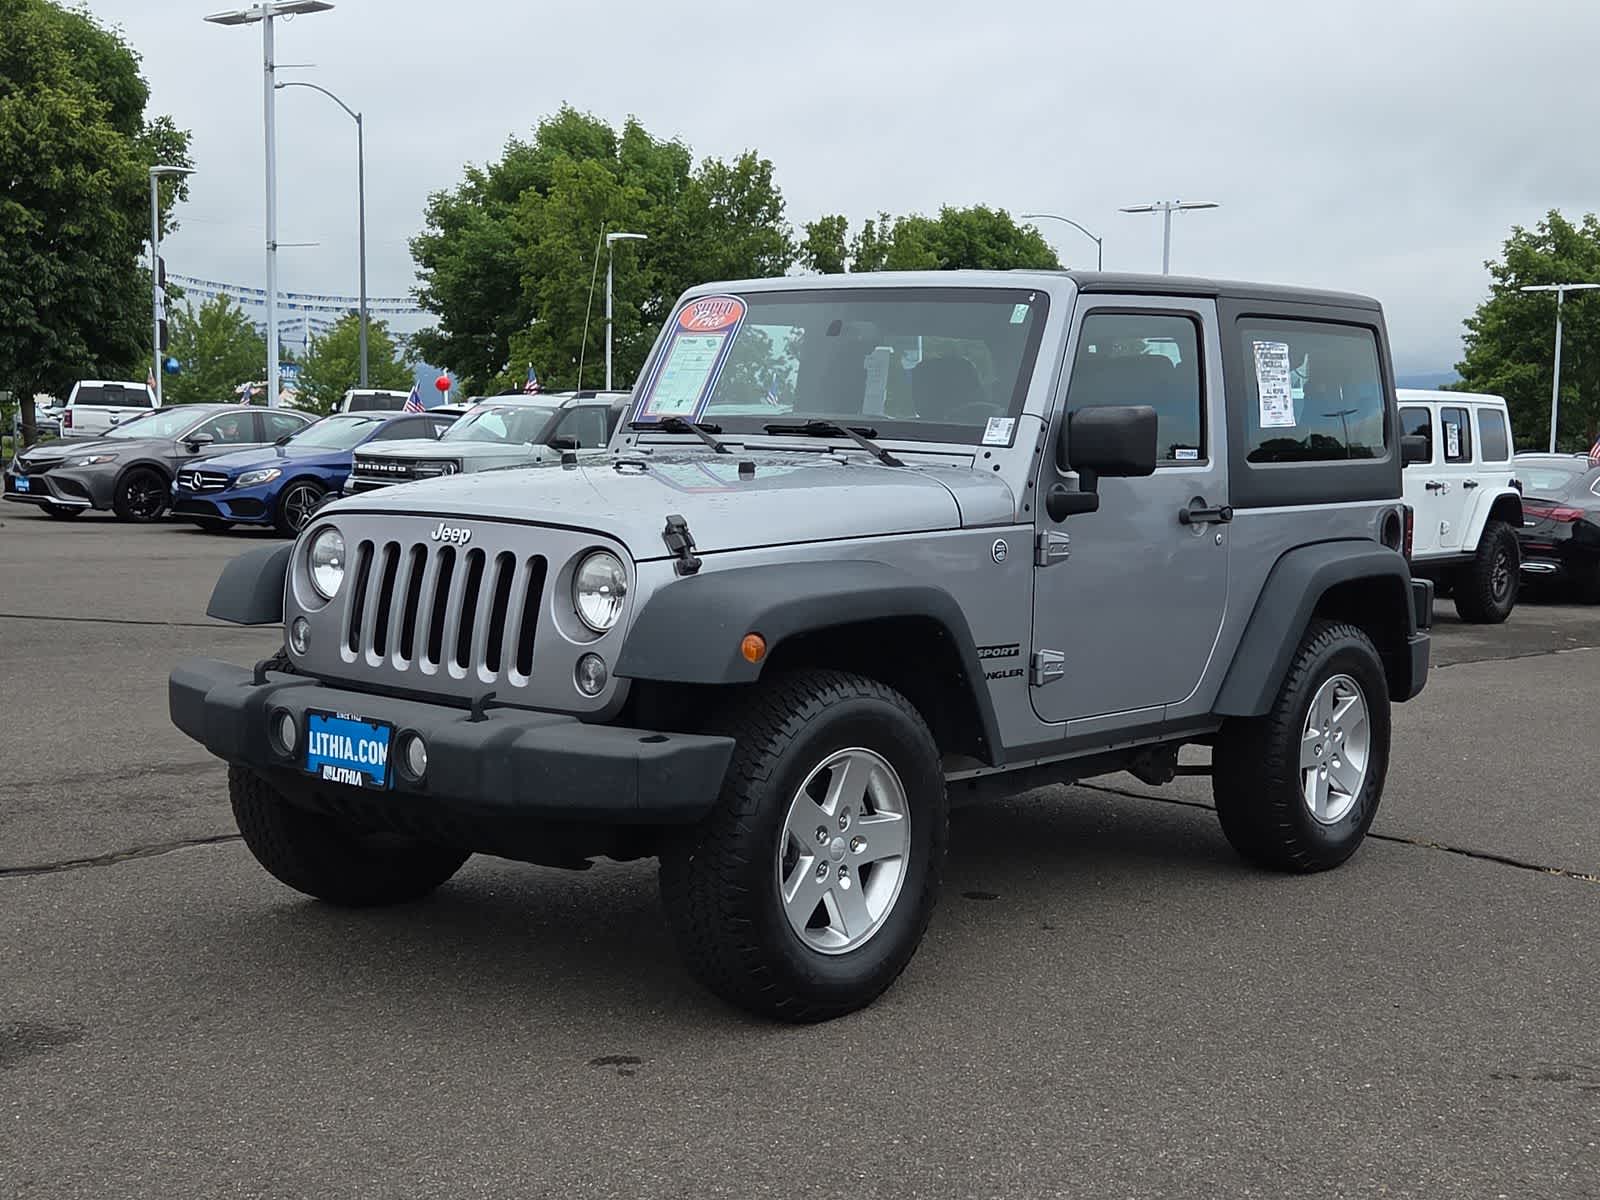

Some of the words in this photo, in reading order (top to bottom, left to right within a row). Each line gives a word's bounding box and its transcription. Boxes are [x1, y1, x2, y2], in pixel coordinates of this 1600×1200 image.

[358, 463, 406, 472] BRONCO
[431, 522, 472, 546] Jeep
[977, 647, 1018, 658] SPORT
[309, 731, 388, 765] LITHIA.COM
[331, 766, 362, 786] LITHIA
